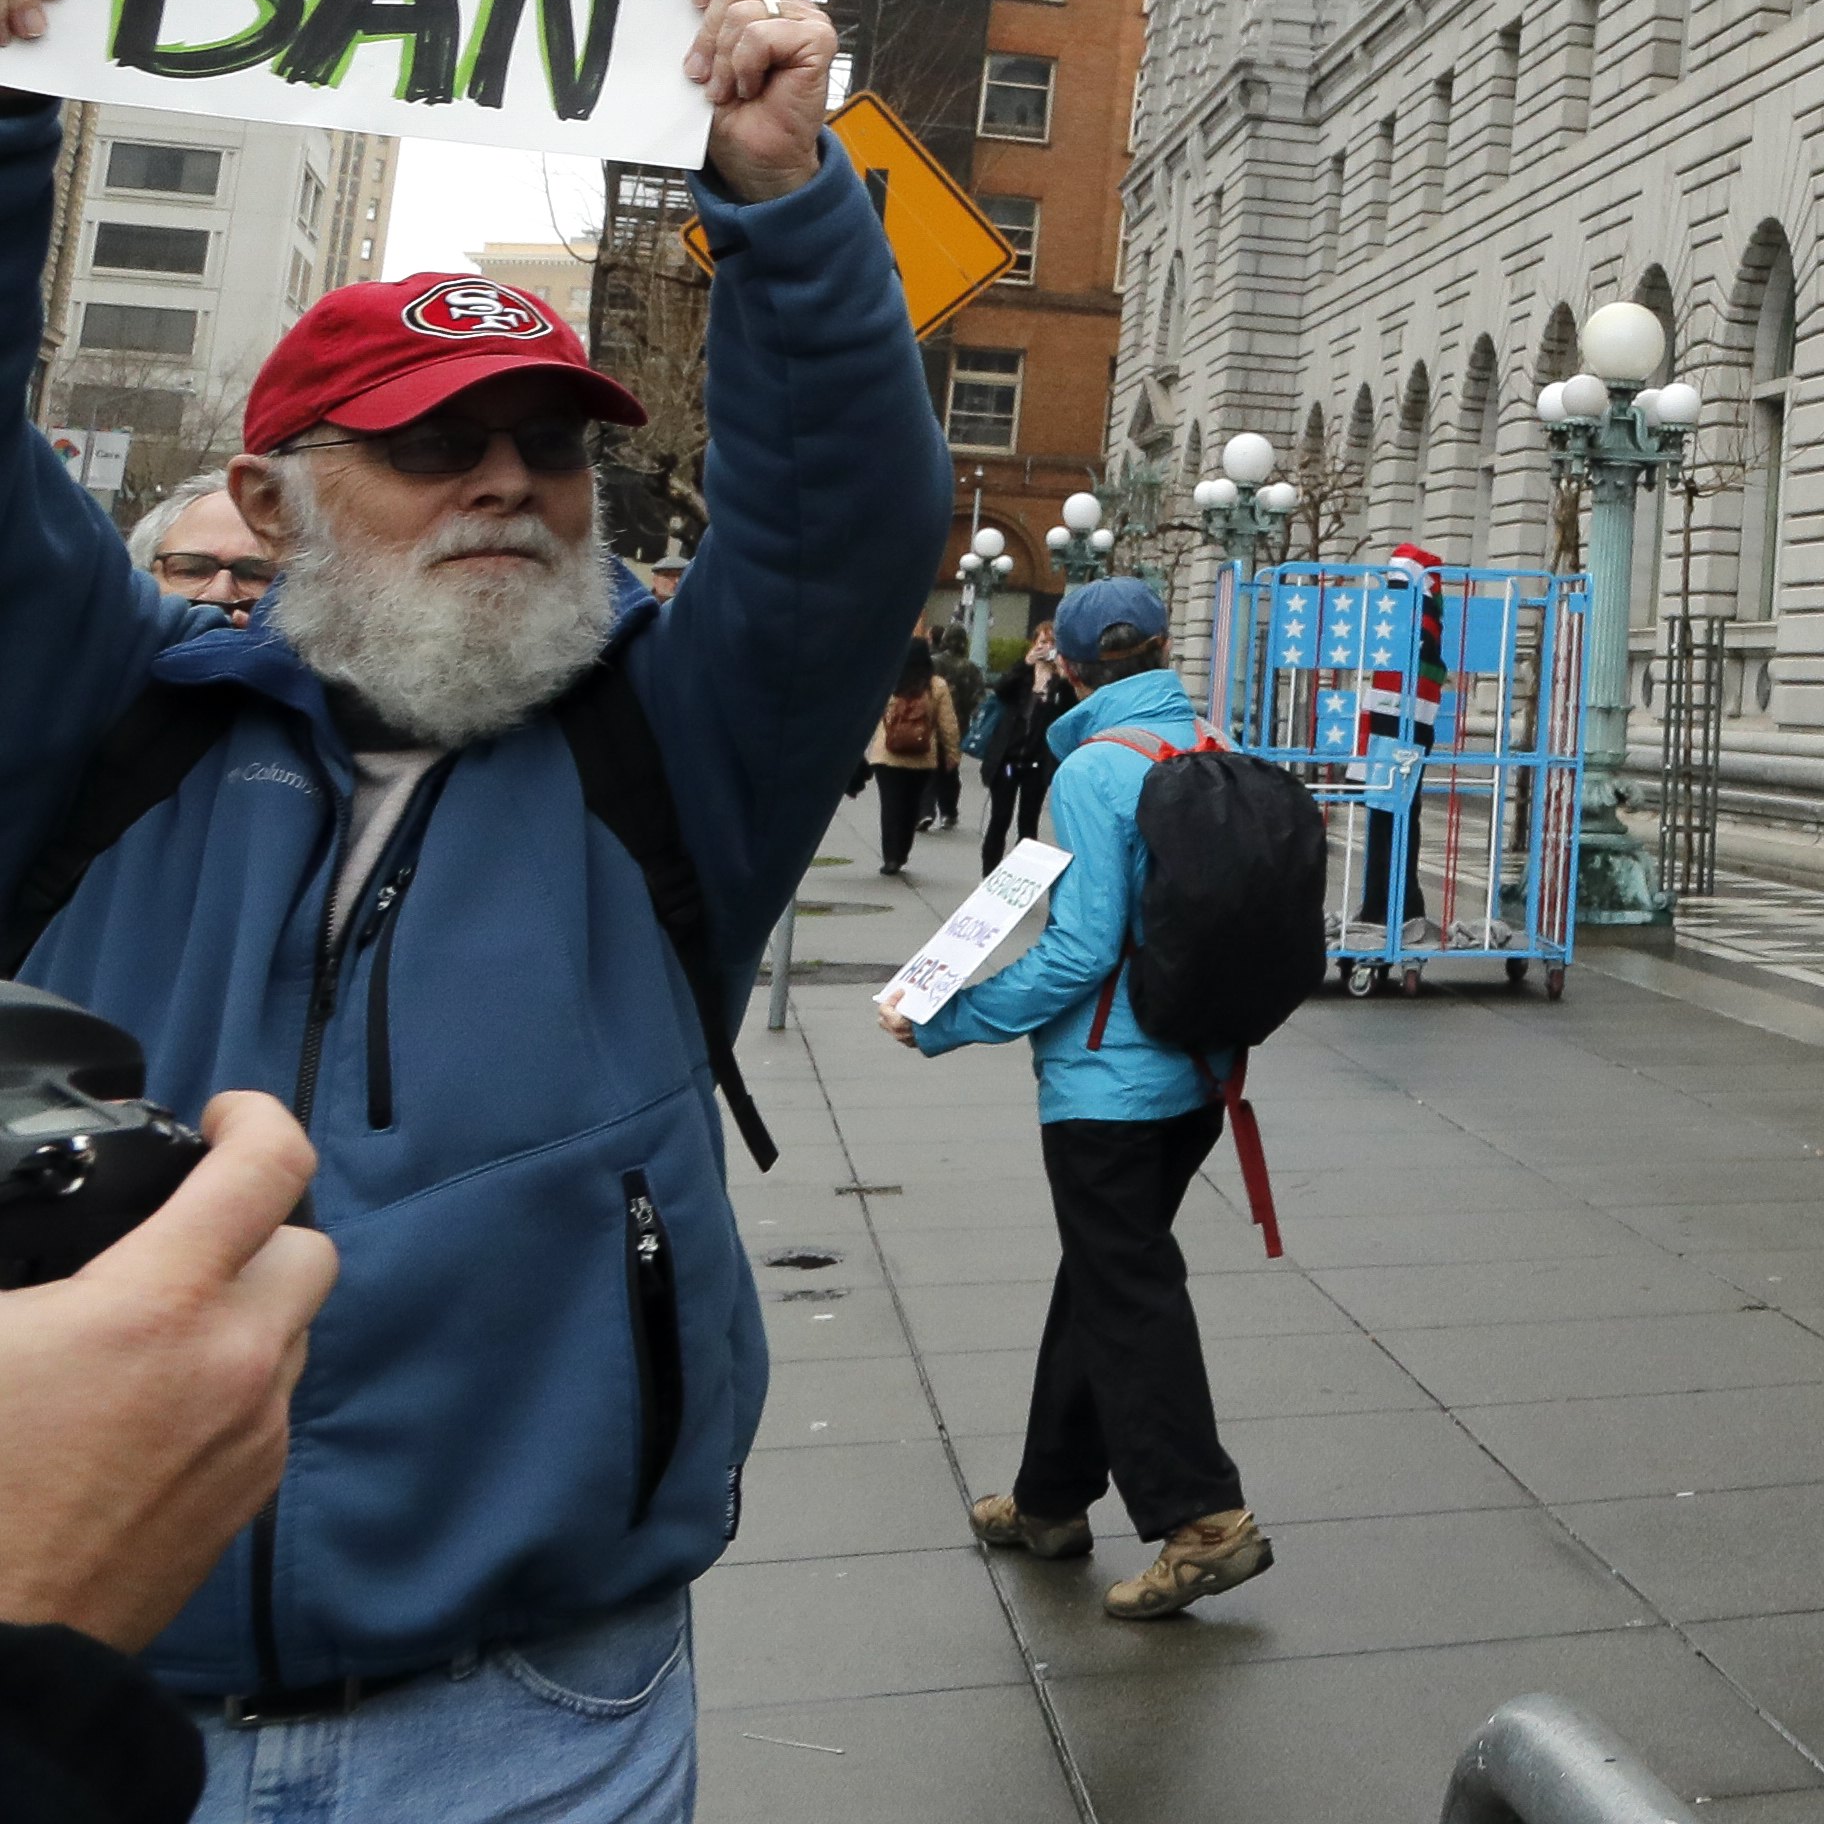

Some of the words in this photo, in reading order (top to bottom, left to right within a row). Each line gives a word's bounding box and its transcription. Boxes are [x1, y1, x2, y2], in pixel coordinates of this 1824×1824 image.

[444, 288, 531, 331] SF
[242, 762, 320, 795] Columb
[899, 953, 949, 991] HERE
